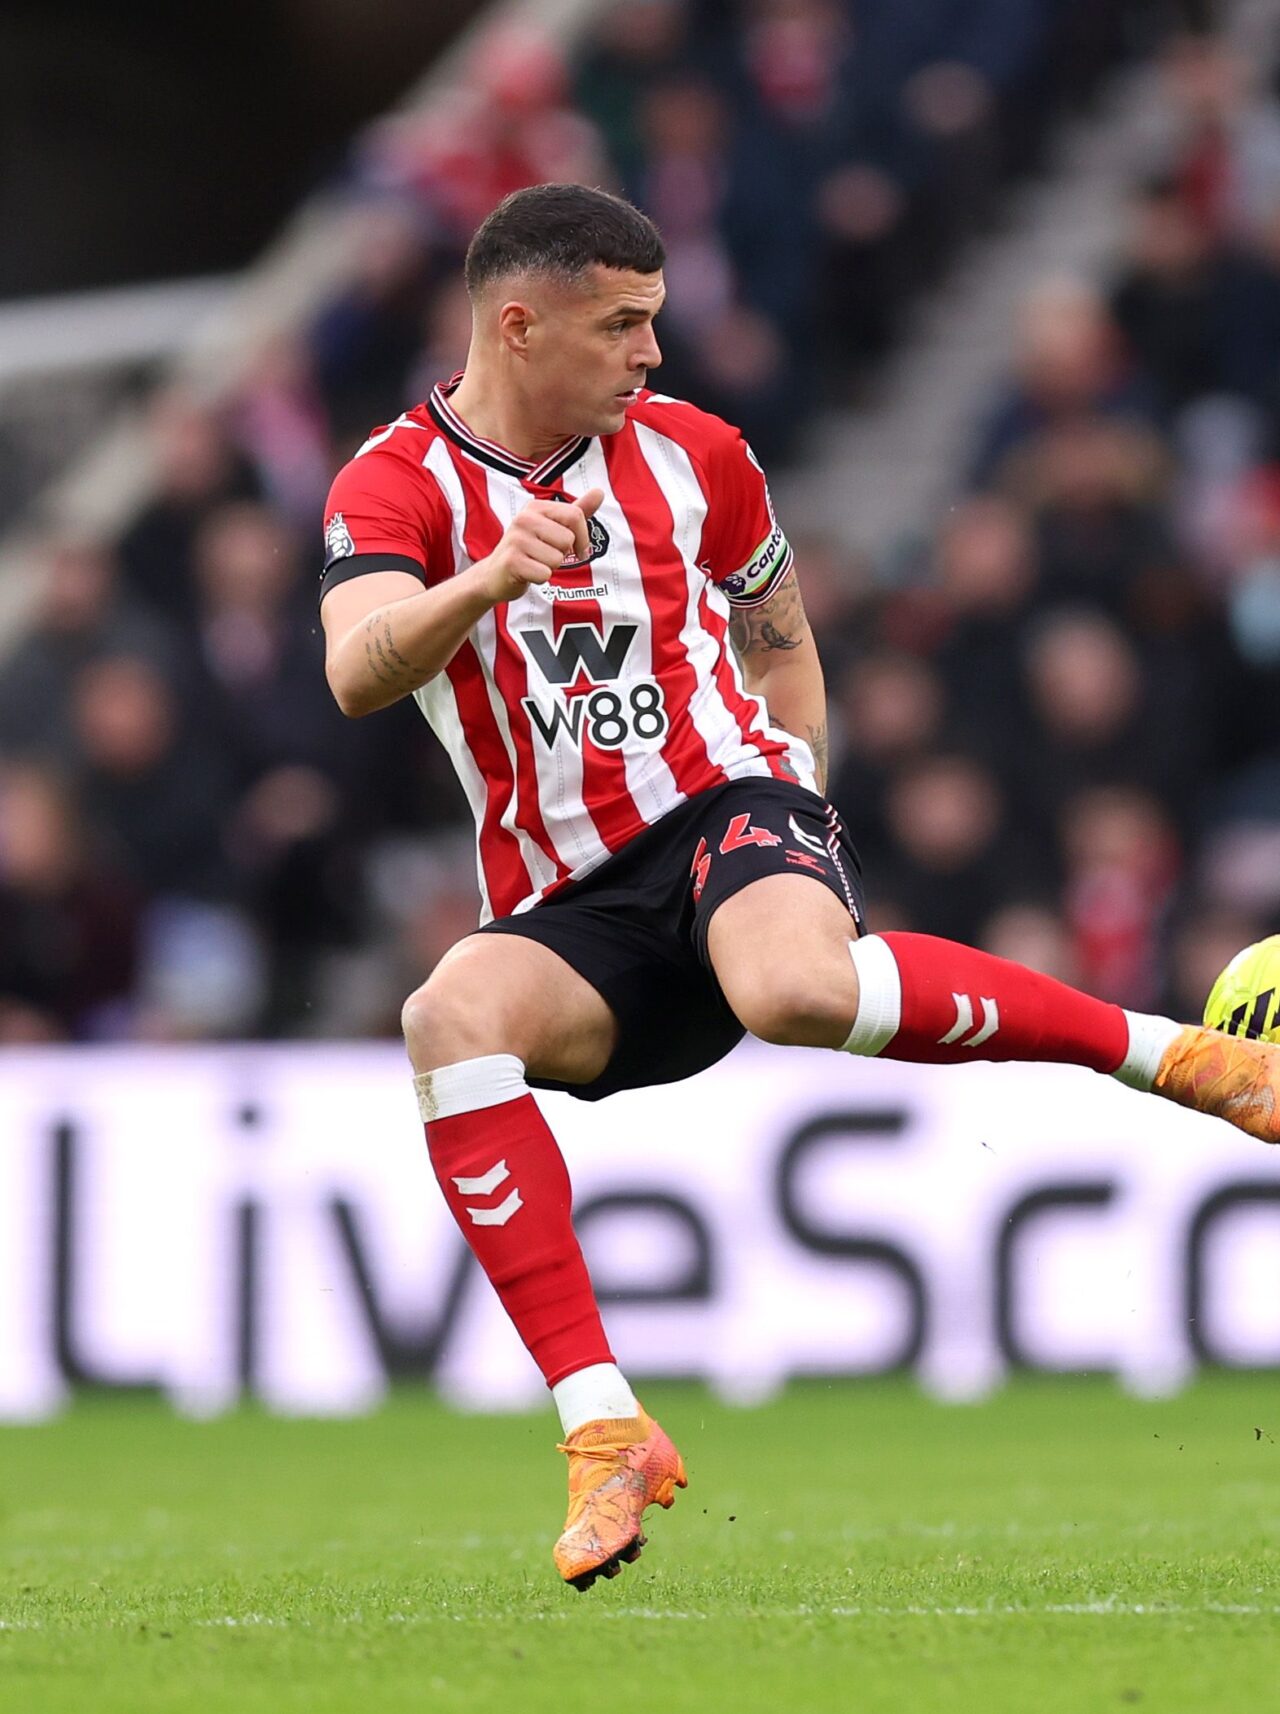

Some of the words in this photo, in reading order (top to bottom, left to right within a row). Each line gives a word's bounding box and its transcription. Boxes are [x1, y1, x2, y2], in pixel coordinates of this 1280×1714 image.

[557, 584, 609, 600] hummel
[519, 625, 639, 684] W
[525, 683, 665, 751] W88
